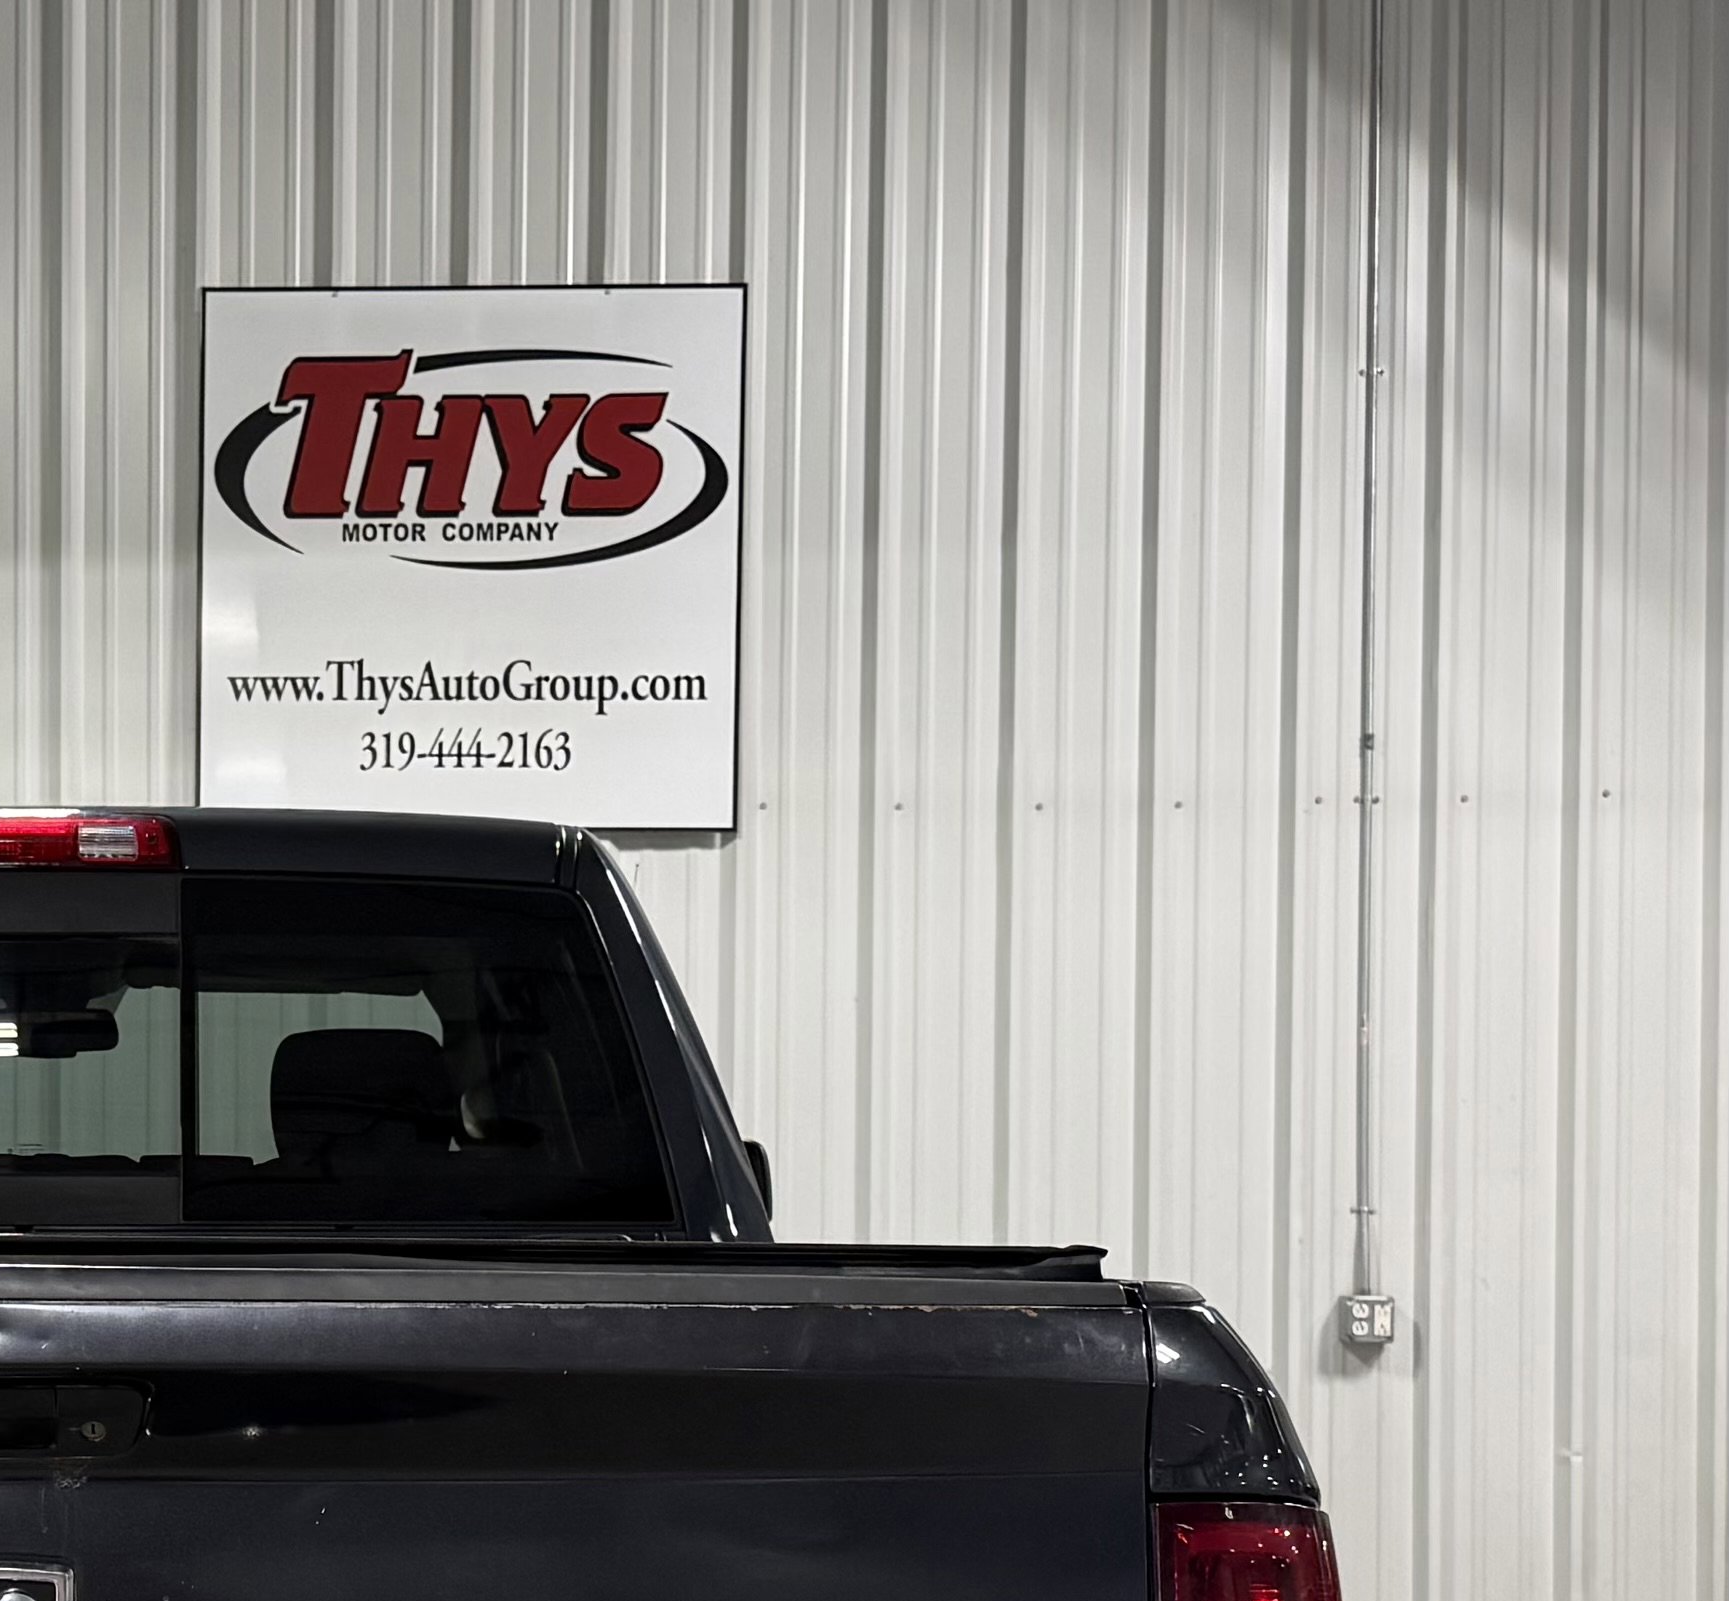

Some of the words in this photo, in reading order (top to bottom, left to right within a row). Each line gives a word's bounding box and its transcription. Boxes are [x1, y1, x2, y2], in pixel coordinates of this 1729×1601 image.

[274, 348, 669, 519] THYS
[341, 523, 426, 543] MOTOR
[441, 522, 559, 543] COMPANY
[227, 659, 708, 716] www.ThysAutoGroup.com
[359, 727, 572, 771] 319-444-2163
